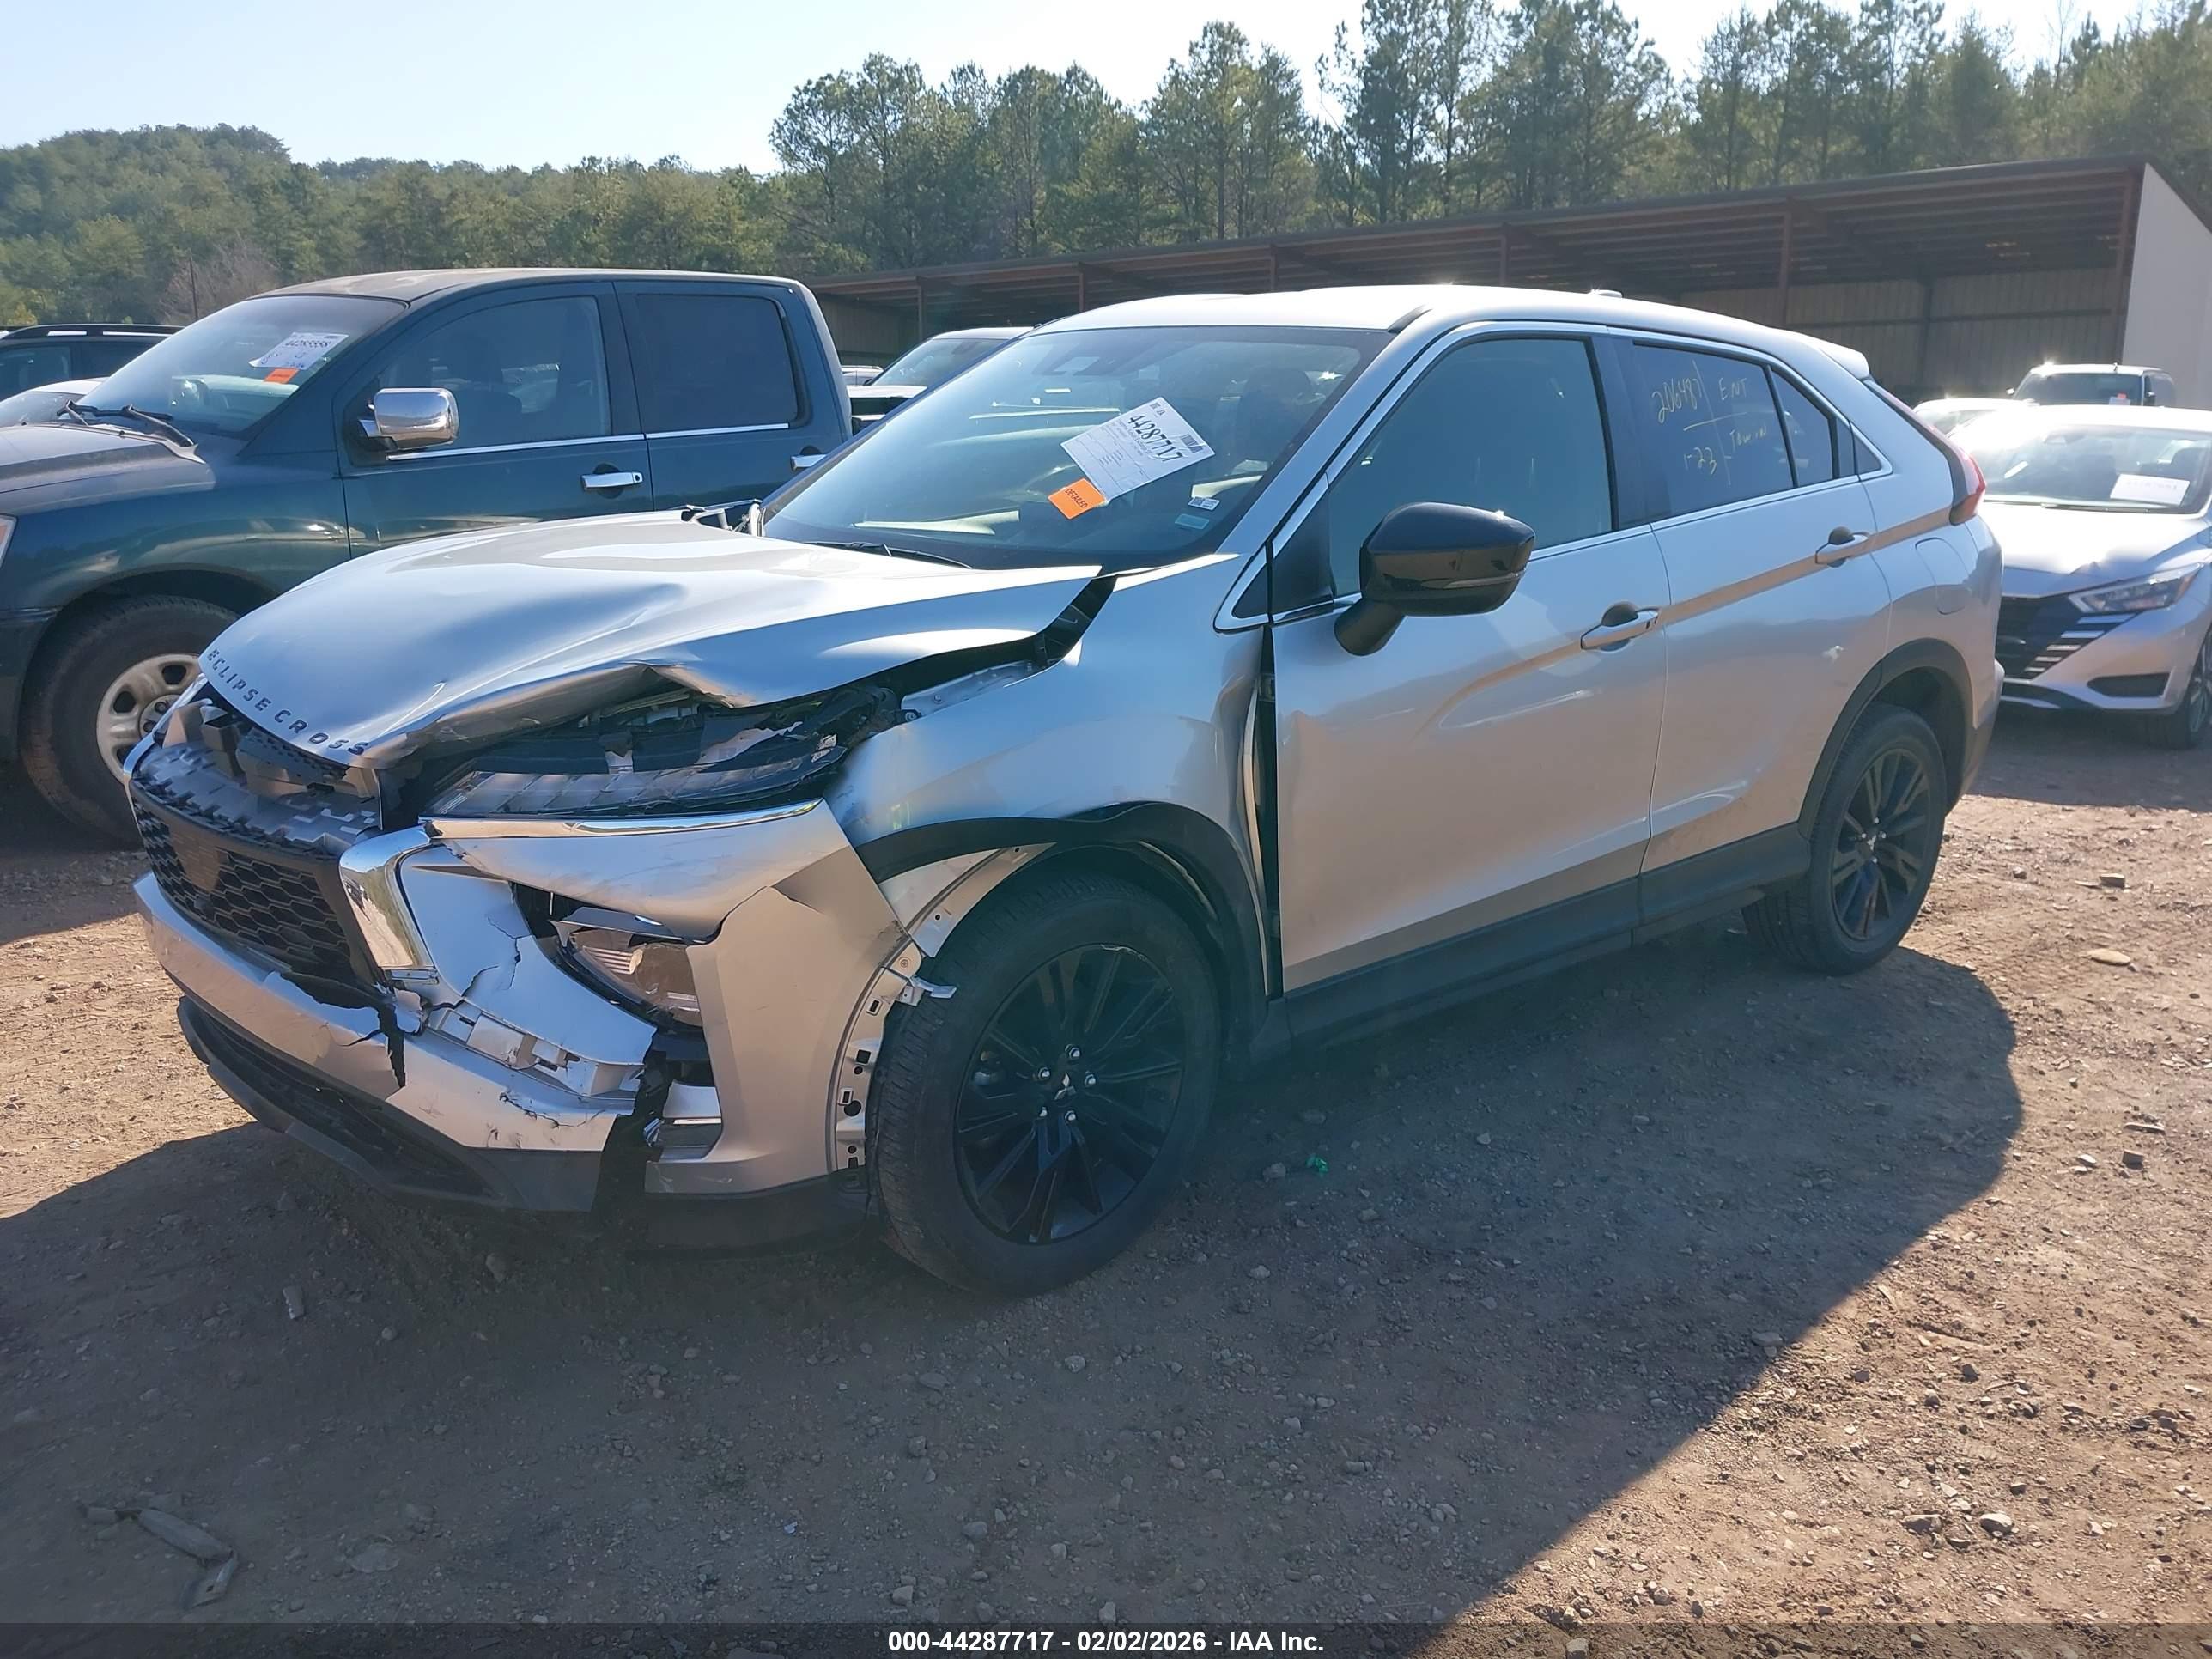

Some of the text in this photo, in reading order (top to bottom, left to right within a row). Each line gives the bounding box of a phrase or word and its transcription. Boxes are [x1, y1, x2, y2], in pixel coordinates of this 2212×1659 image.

[1718, 377, 1747, 401] ENT
[1127, 414, 1183, 462] 44287717
[1064, 487, 1089, 508] DETAILED
[207, 648, 369, 756] ECLIPSE CROSS
